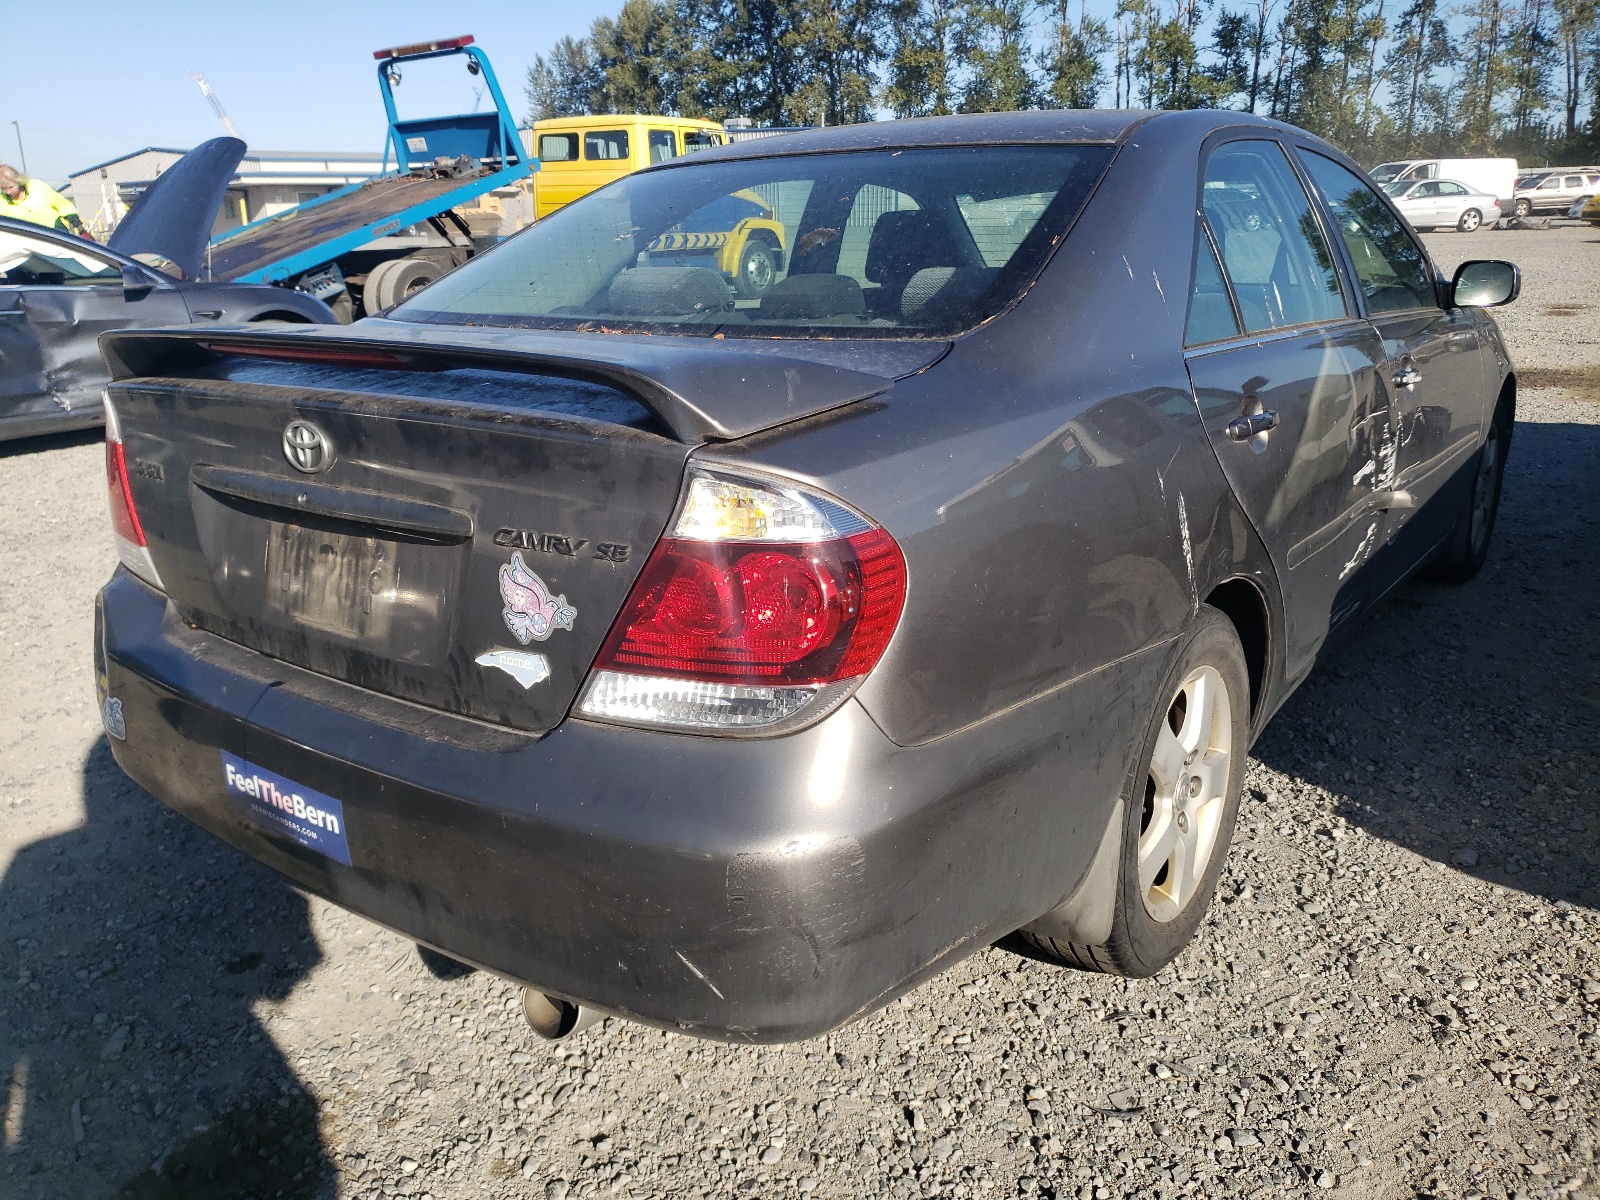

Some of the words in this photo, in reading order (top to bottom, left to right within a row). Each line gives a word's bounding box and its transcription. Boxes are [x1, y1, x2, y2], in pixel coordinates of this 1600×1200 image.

[493, 528, 588, 556] CAMRY
[592, 542, 630, 563] SE
[499, 655, 535, 671] home.
